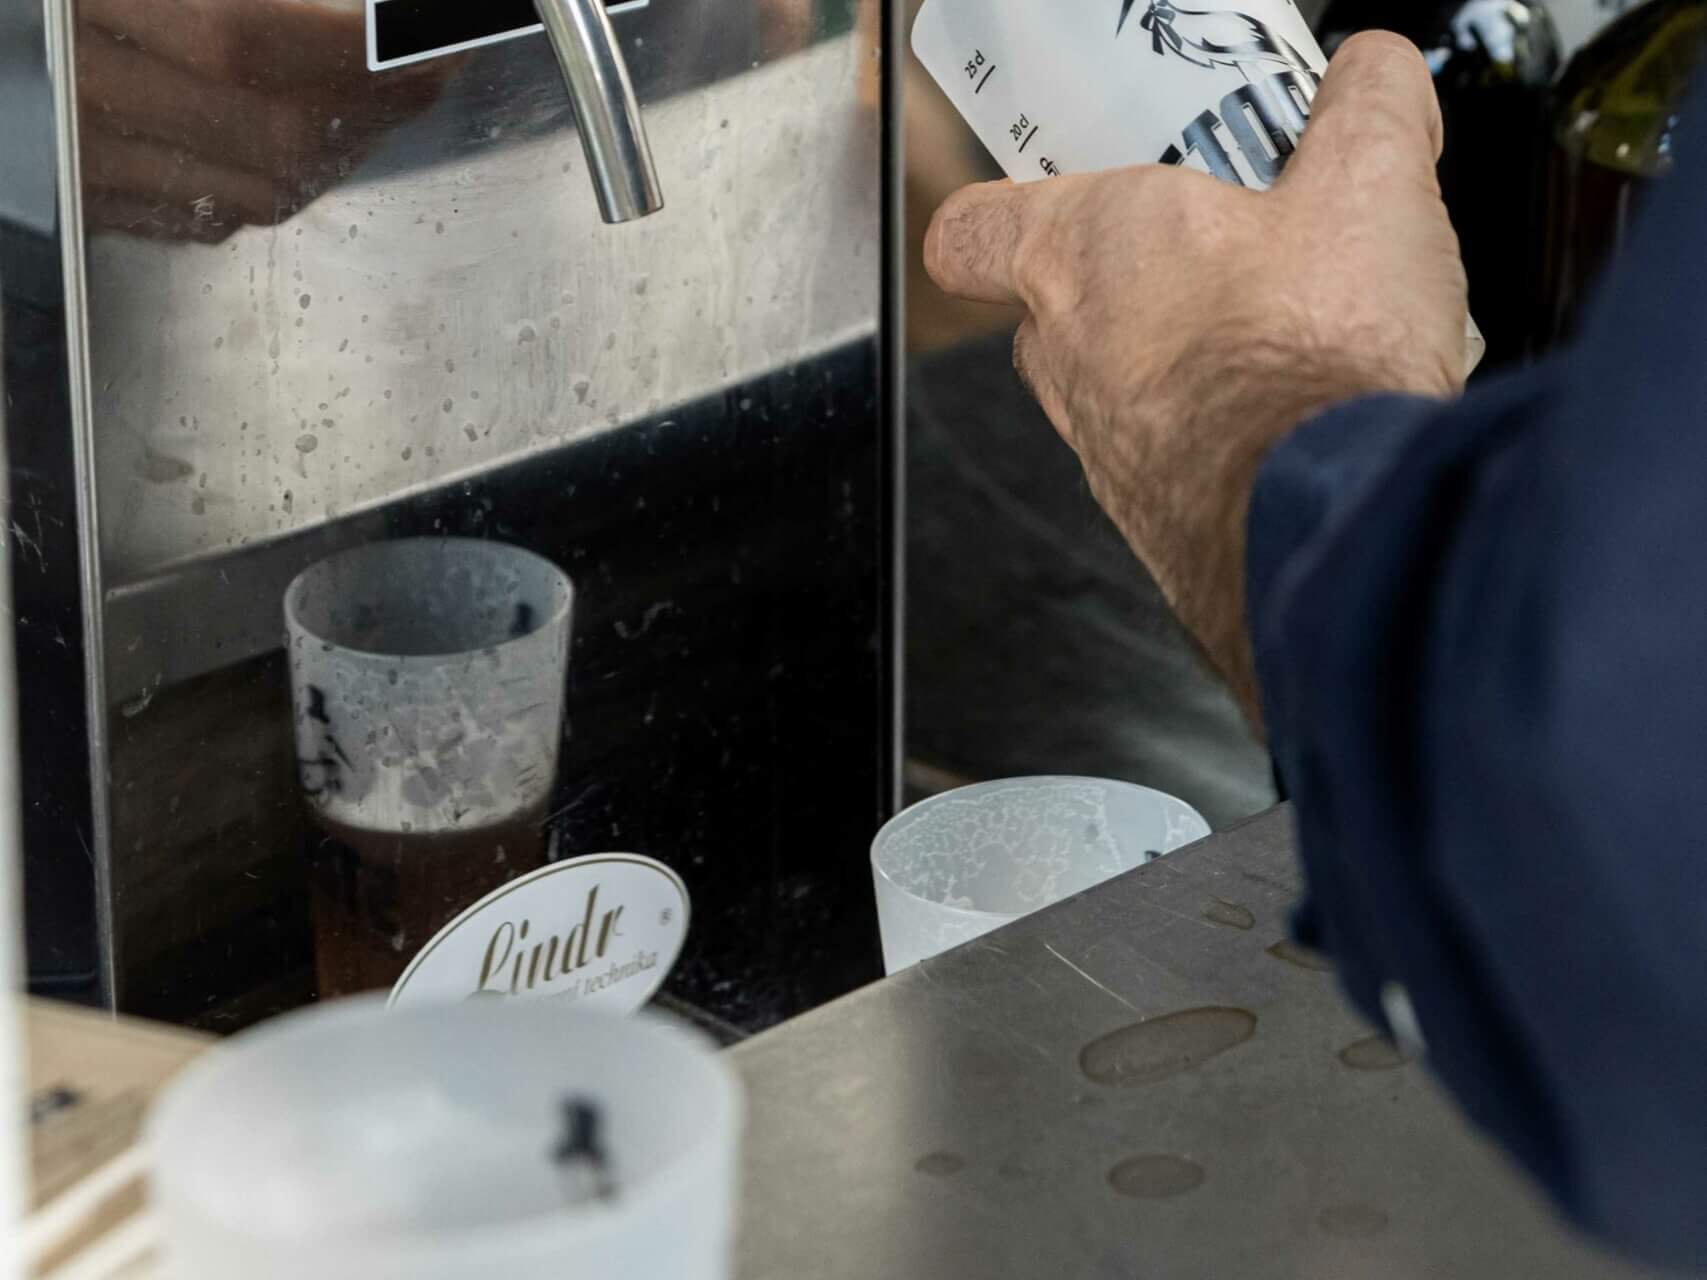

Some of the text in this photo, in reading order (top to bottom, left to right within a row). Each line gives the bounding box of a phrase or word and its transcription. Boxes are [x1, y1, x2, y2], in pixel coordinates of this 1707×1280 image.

[964, 60, 978, 80] 25
[1009, 123, 1023, 141] 20
[478, 885, 625, 994] Lindr
